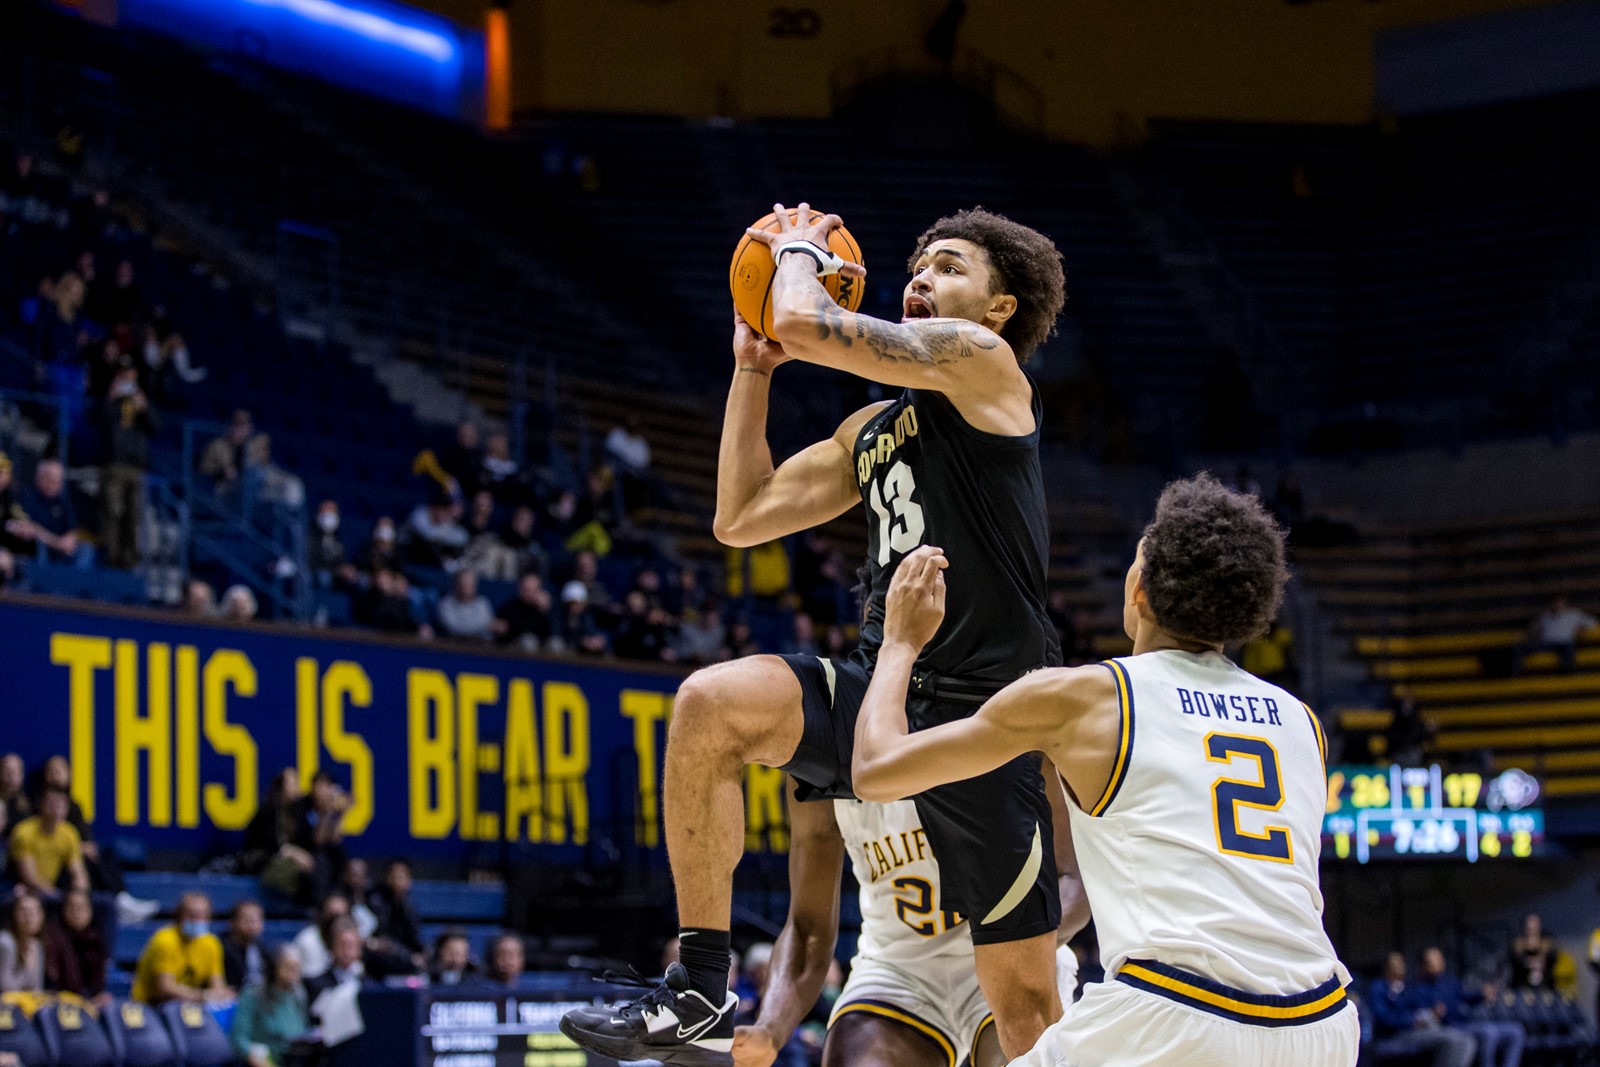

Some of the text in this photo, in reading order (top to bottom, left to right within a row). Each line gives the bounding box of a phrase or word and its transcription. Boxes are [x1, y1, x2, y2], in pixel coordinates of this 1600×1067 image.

[869, 459, 925, 568] 13
[1176, 687, 1283, 727] BOWSER
[50, 631, 258, 831] THIS
[296, 656, 373, 837] IS
[407, 668, 591, 846] BEAR
[1202, 730, 1294, 865] 2
[1351, 774, 1390, 808] 26
[1443, 773, 1482, 807] 17
[863, 827, 935, 884] CALIF
[1391, 818, 1460, 853] 7:26
